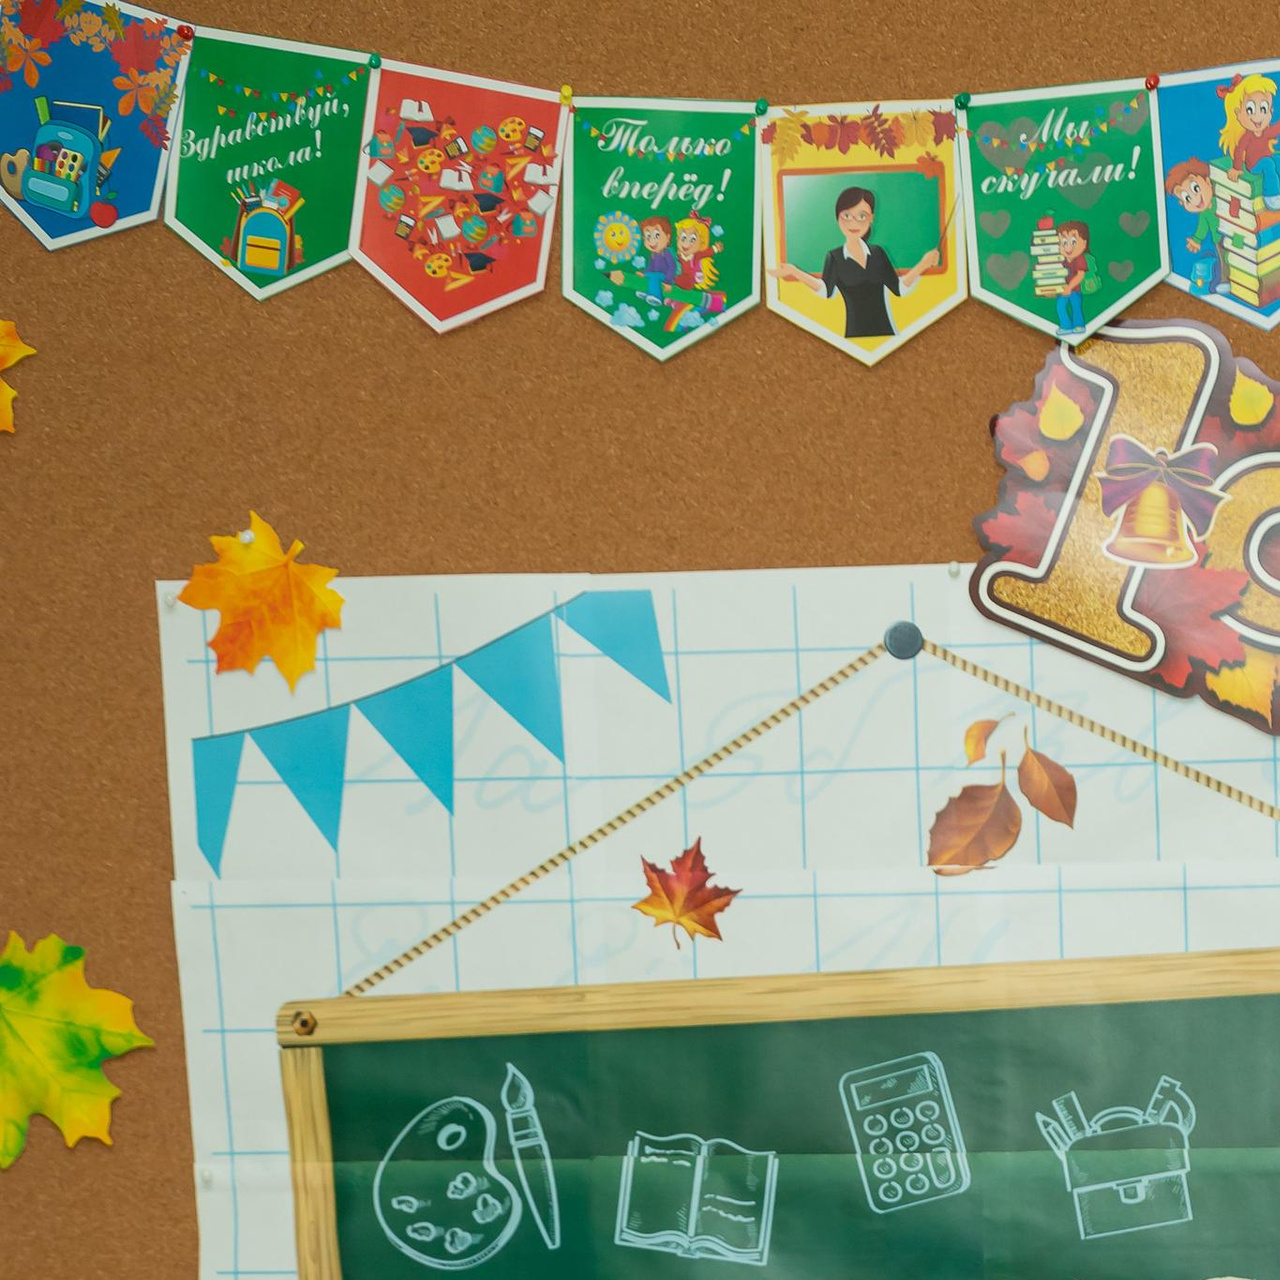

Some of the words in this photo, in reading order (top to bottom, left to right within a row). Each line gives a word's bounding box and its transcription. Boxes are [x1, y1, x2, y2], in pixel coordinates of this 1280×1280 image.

[179, 91, 349, 162] Здравствуй,
[597, 117, 732, 157] Только
[1019, 107, 1091, 144] Мы
[226, 129, 322, 184] школа!
[981, 145, 1141, 200] скучали!
[601, 165, 732, 210] вперёд!
[979, 323, 1221, 673] 1
